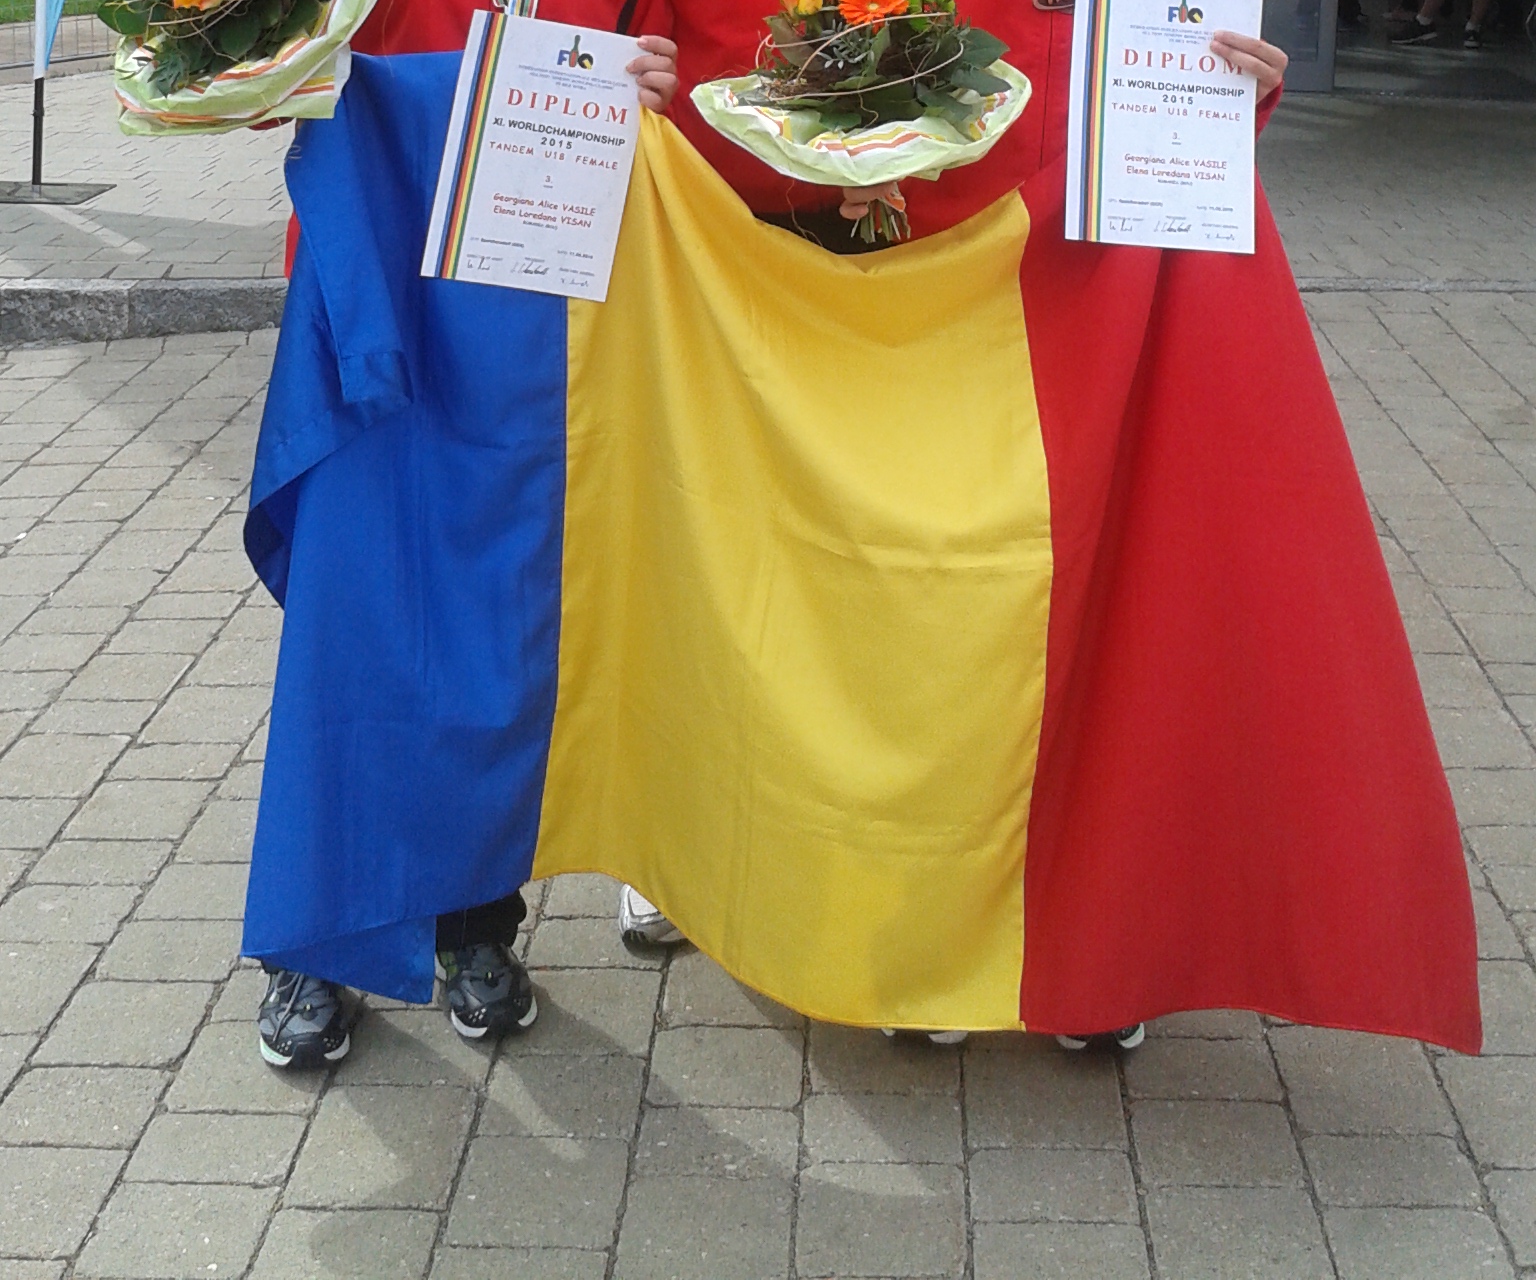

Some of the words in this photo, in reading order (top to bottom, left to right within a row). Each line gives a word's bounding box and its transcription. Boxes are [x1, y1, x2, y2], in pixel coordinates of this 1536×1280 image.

[1123, 48, 1244, 75] DIPLOM
[1127, 79, 1245, 98] WORLDCHAMPIONSHIP
[507, 87, 629, 125] DIPLOM
[1162, 94, 1194, 105] 2015
[1112, 102, 1157, 113] TANDEM
[1167, 107, 1188, 116] U18
[1198, 109, 1241, 121] FEMALE
[508, 119, 626, 147] WORLDCHAMPIONSHIP
[540, 136, 573, 150] 2015
[489, 141, 534, 156] TANDEM
[544, 150, 566, 161] U18
[575, 155, 619, 171] FEMALE
[1124, 153, 1166, 165] Georgiana
[1169, 157, 1190, 166] Alice
[1193, 158, 1228, 170] VASILE
[1126, 165, 1149, 175] Elena
[1152, 167, 1191, 179] Loredana
[1194, 171, 1226, 181] VISAN
[493, 192, 535, 206] Georgiana
[537, 200, 559, 210] Alice
[562, 203, 597, 217] VASILE
[493, 205, 516, 216] Elena
[518, 209, 558, 223] Loredana
[560, 216, 592, 229] VISAN
